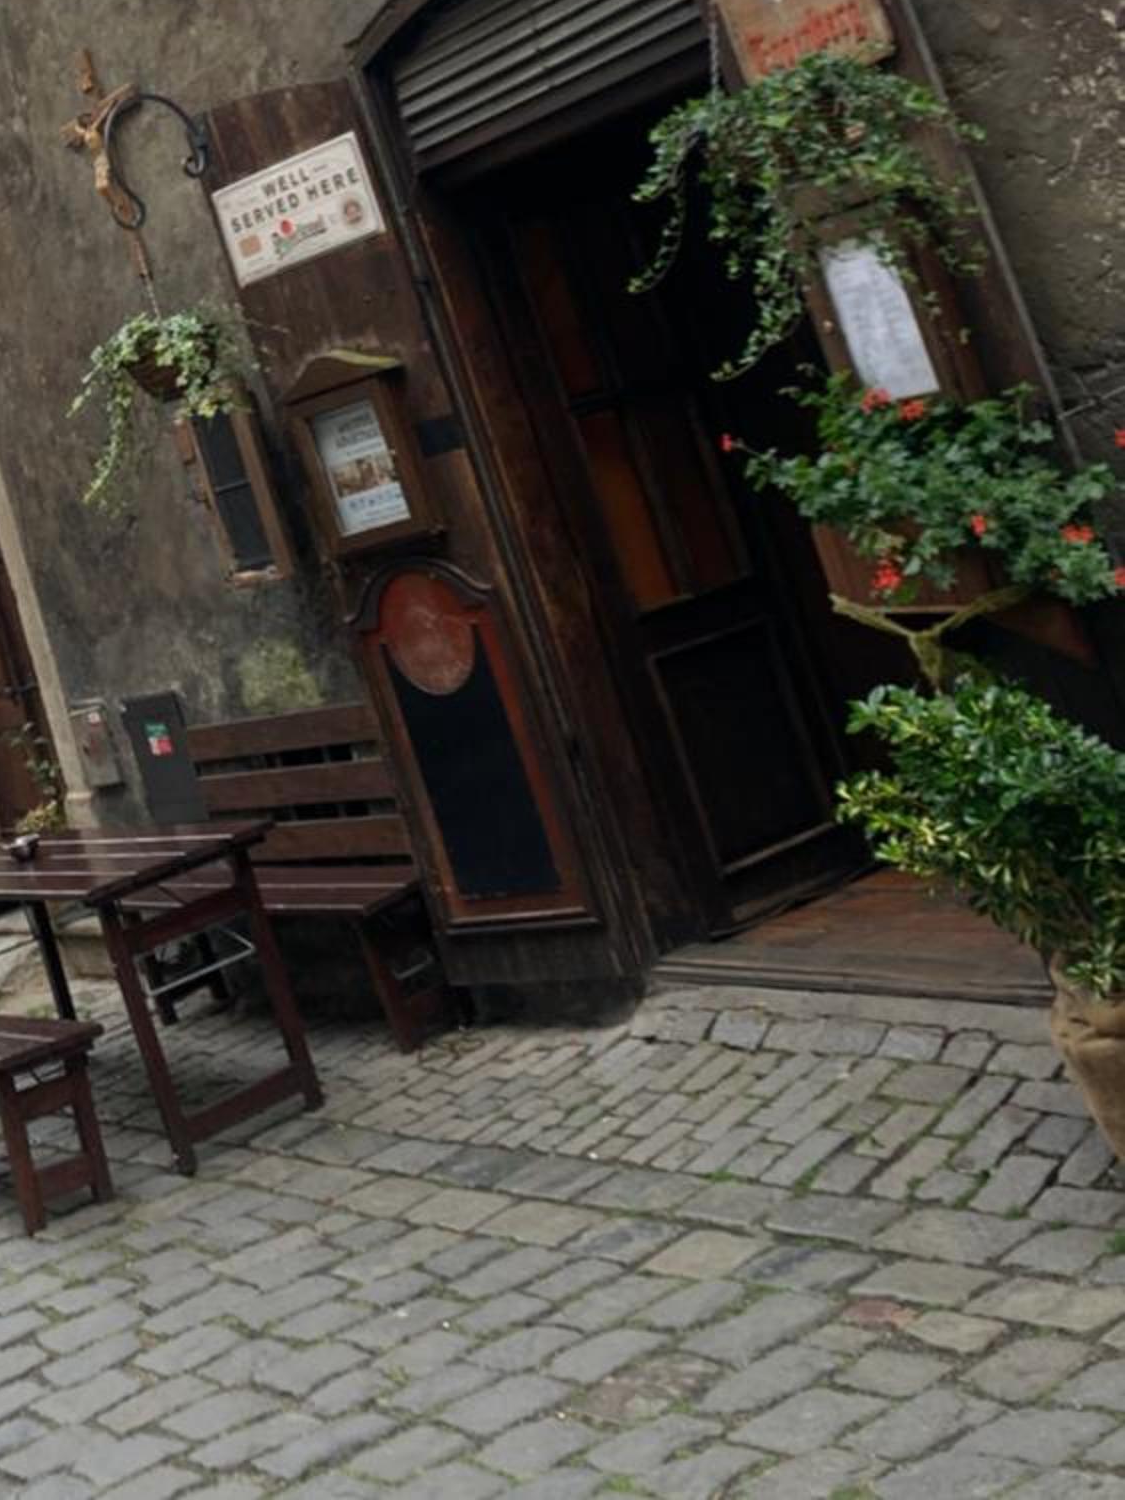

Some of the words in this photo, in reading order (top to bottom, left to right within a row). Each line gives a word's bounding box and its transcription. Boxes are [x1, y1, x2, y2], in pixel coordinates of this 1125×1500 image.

[231, 192, 299, 233] SERVED
[305, 166, 359, 201] HERE
[261, 167, 310, 197] WELL
